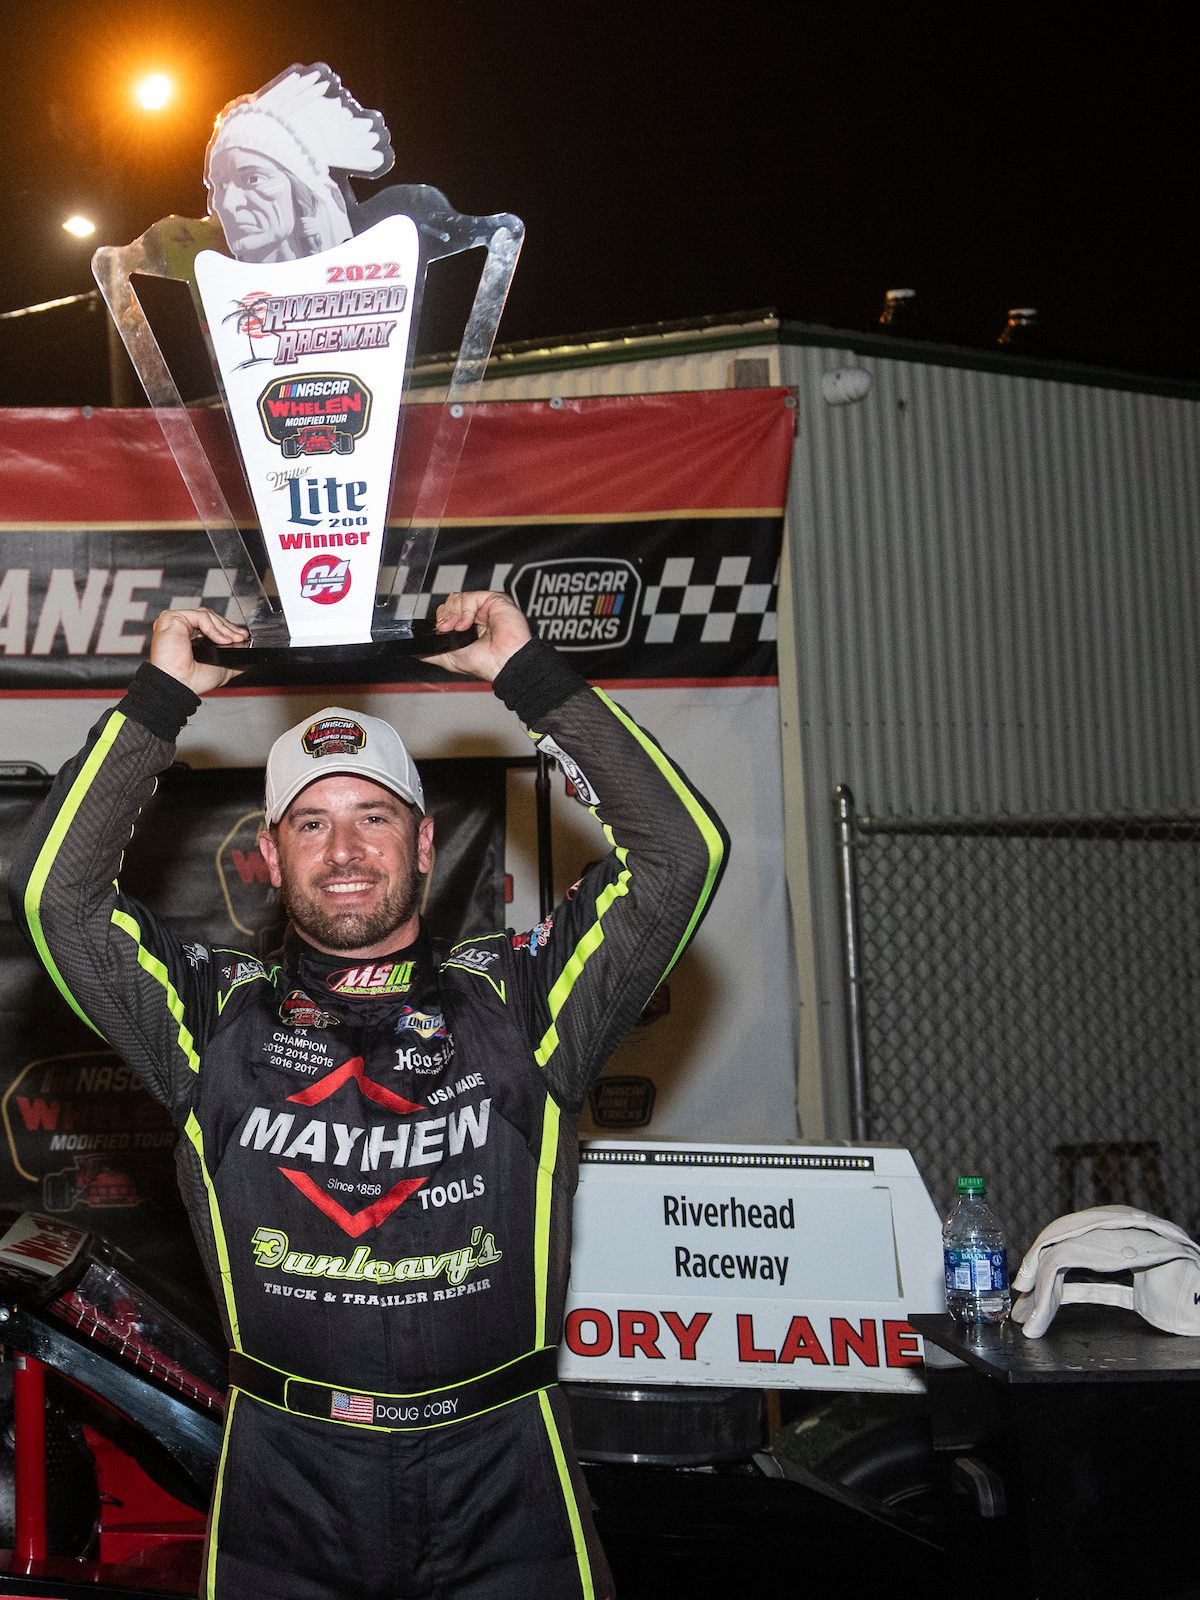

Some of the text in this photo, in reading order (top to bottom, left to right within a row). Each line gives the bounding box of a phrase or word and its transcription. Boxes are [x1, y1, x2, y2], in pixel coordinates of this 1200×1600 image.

[326, 262, 401, 285] 2022
[260, 285, 408, 333] RIVERHEAD
[273, 320, 398, 366] RACEWAY
[296, 380, 350, 397] NASCAR
[267, 392, 362, 418] WHELEN
[285, 414, 348, 427] MODIFIED TOUR
[266, 466, 313, 492] Miller
[287, 477, 368, 526] Lite
[329, 517, 368, 528] 200
[279, 530, 371, 551] Winner
[540, 570, 629, 594] NASCAR
[527, 592, 594, 618] HOME
[537, 618, 621, 641] TRACKS
[262, 1043, 334, 1068] 2012 2014 2015
[273, 1032, 327, 1054] CHAMPION
[270, 1056, 319, 1075] 2016 2017
[428, 1072, 486, 1106] USA MADE
[239, 1098, 492, 1172] MAYHEW
[327, 1178, 382, 1196] Since 1856
[417, 1174, 486, 1210] TOOLS
[663, 1195, 796, 1230] Riverhead
[251, 1226, 503, 1285] Dunleavy's
[674, 1246, 789, 1286] Raceway
[263, 1278, 491, 1307] TRUCK & TRAILER REPAIR
[736, 1313, 924, 1369] LANE
[377, 1398, 458, 1421] DOUG COBY
